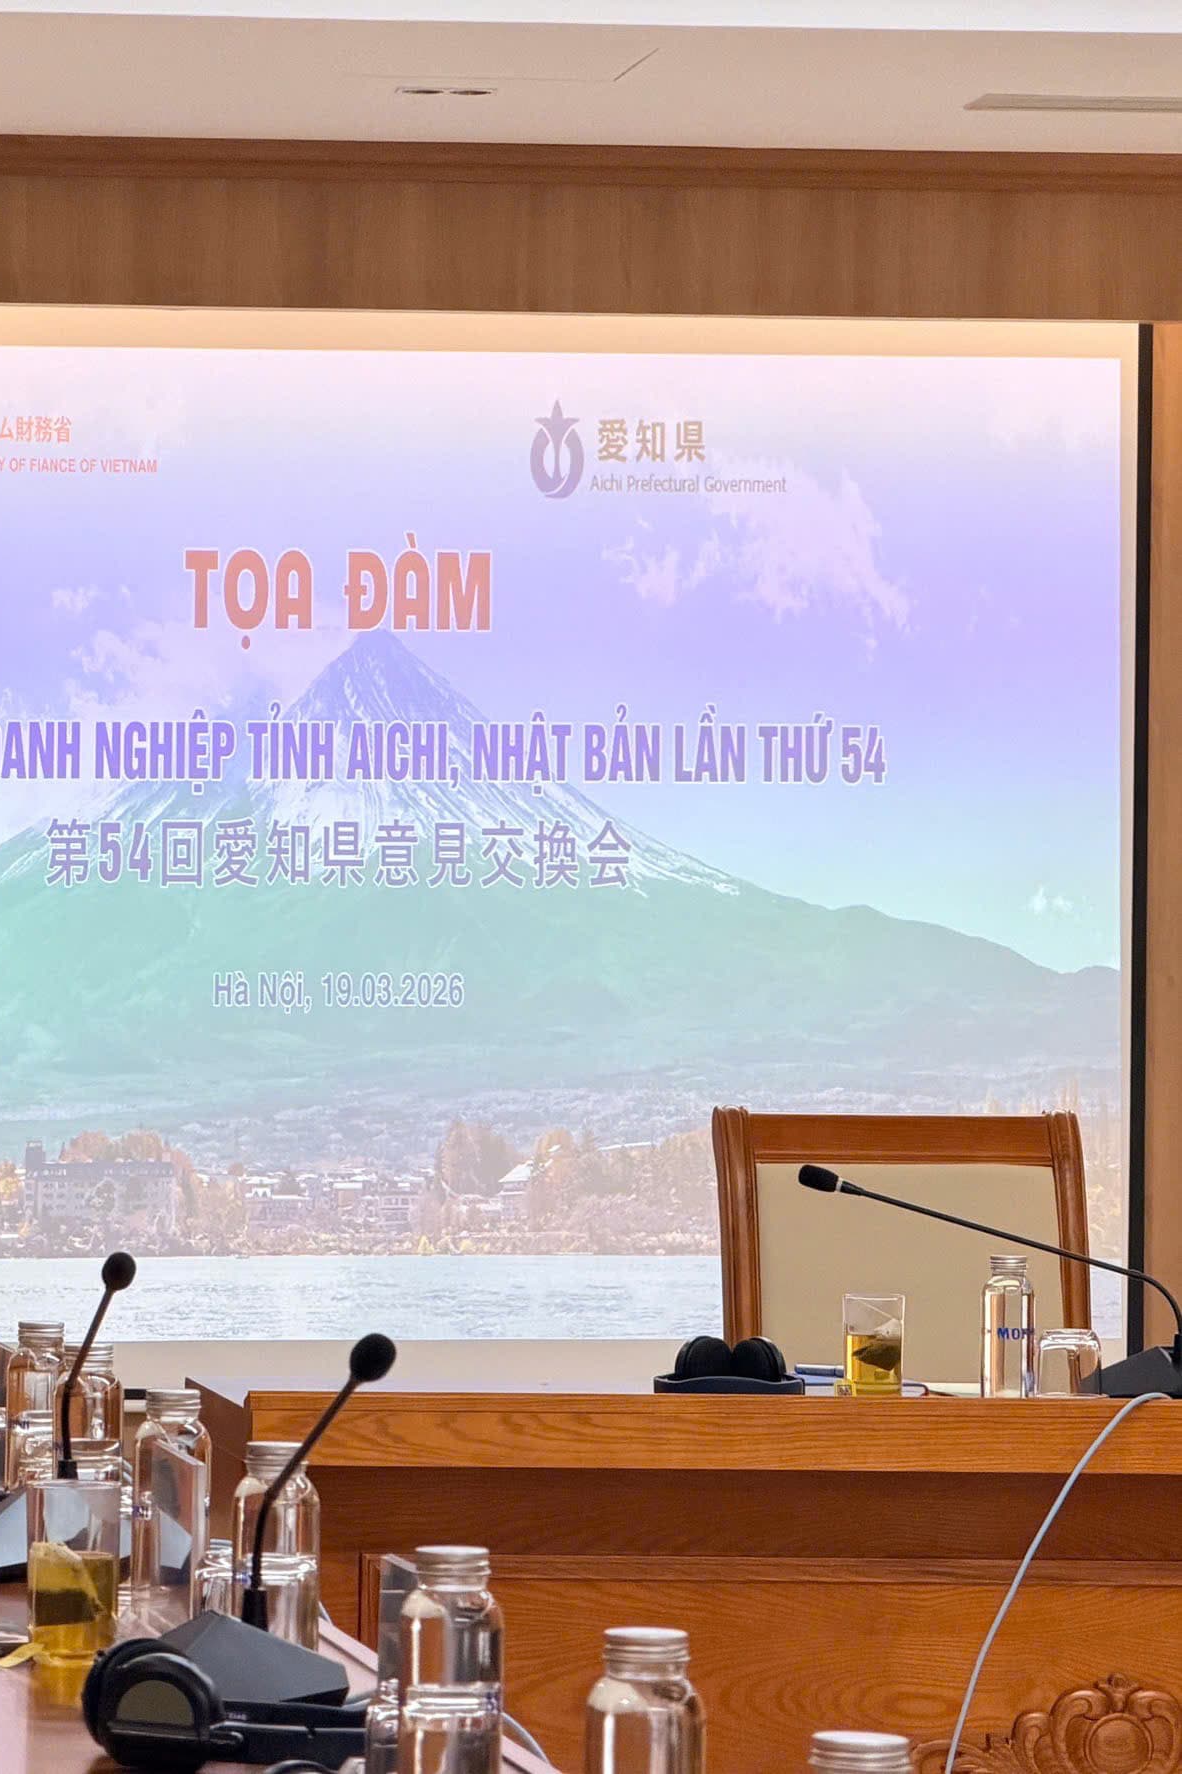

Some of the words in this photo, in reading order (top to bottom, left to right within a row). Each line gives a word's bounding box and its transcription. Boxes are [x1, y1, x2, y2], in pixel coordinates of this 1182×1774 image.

[596, 418, 707, 464] 愛知県
[9, 458, 26, 473] OF
[30, 458, 76, 474] FIANCE
[80, 459, 96, 474] OF
[100, 459, 157, 474] VIETNAM
[590, 473, 623, 492] Aichi
[627, 474, 700, 493] Prefectural
[704, 475, 787, 494] Government
[184, 547, 314, 651] TỌA
[344, 532, 493, 632] ĐÀM
[94, 709, 236, 795] NGHIỆP
[246, 701, 335, 783] TỈNH
[346, 721, 460, 789] AICHI,
[472, 711, 573, 795] NHẬT
[583, 703, 662, 784] BẢN
[673, 703, 747, 785] LẦN
[759, 712, 834, 785] THỨ
[840, 724, 887, 785] 54
[46, 817, 632, 890] 第54回愛知県意見交換会
[213, 971, 250, 1007] Hà
[258, 971, 313, 1014] Nội,
[321, 972, 465, 1008] 19.03.2026
